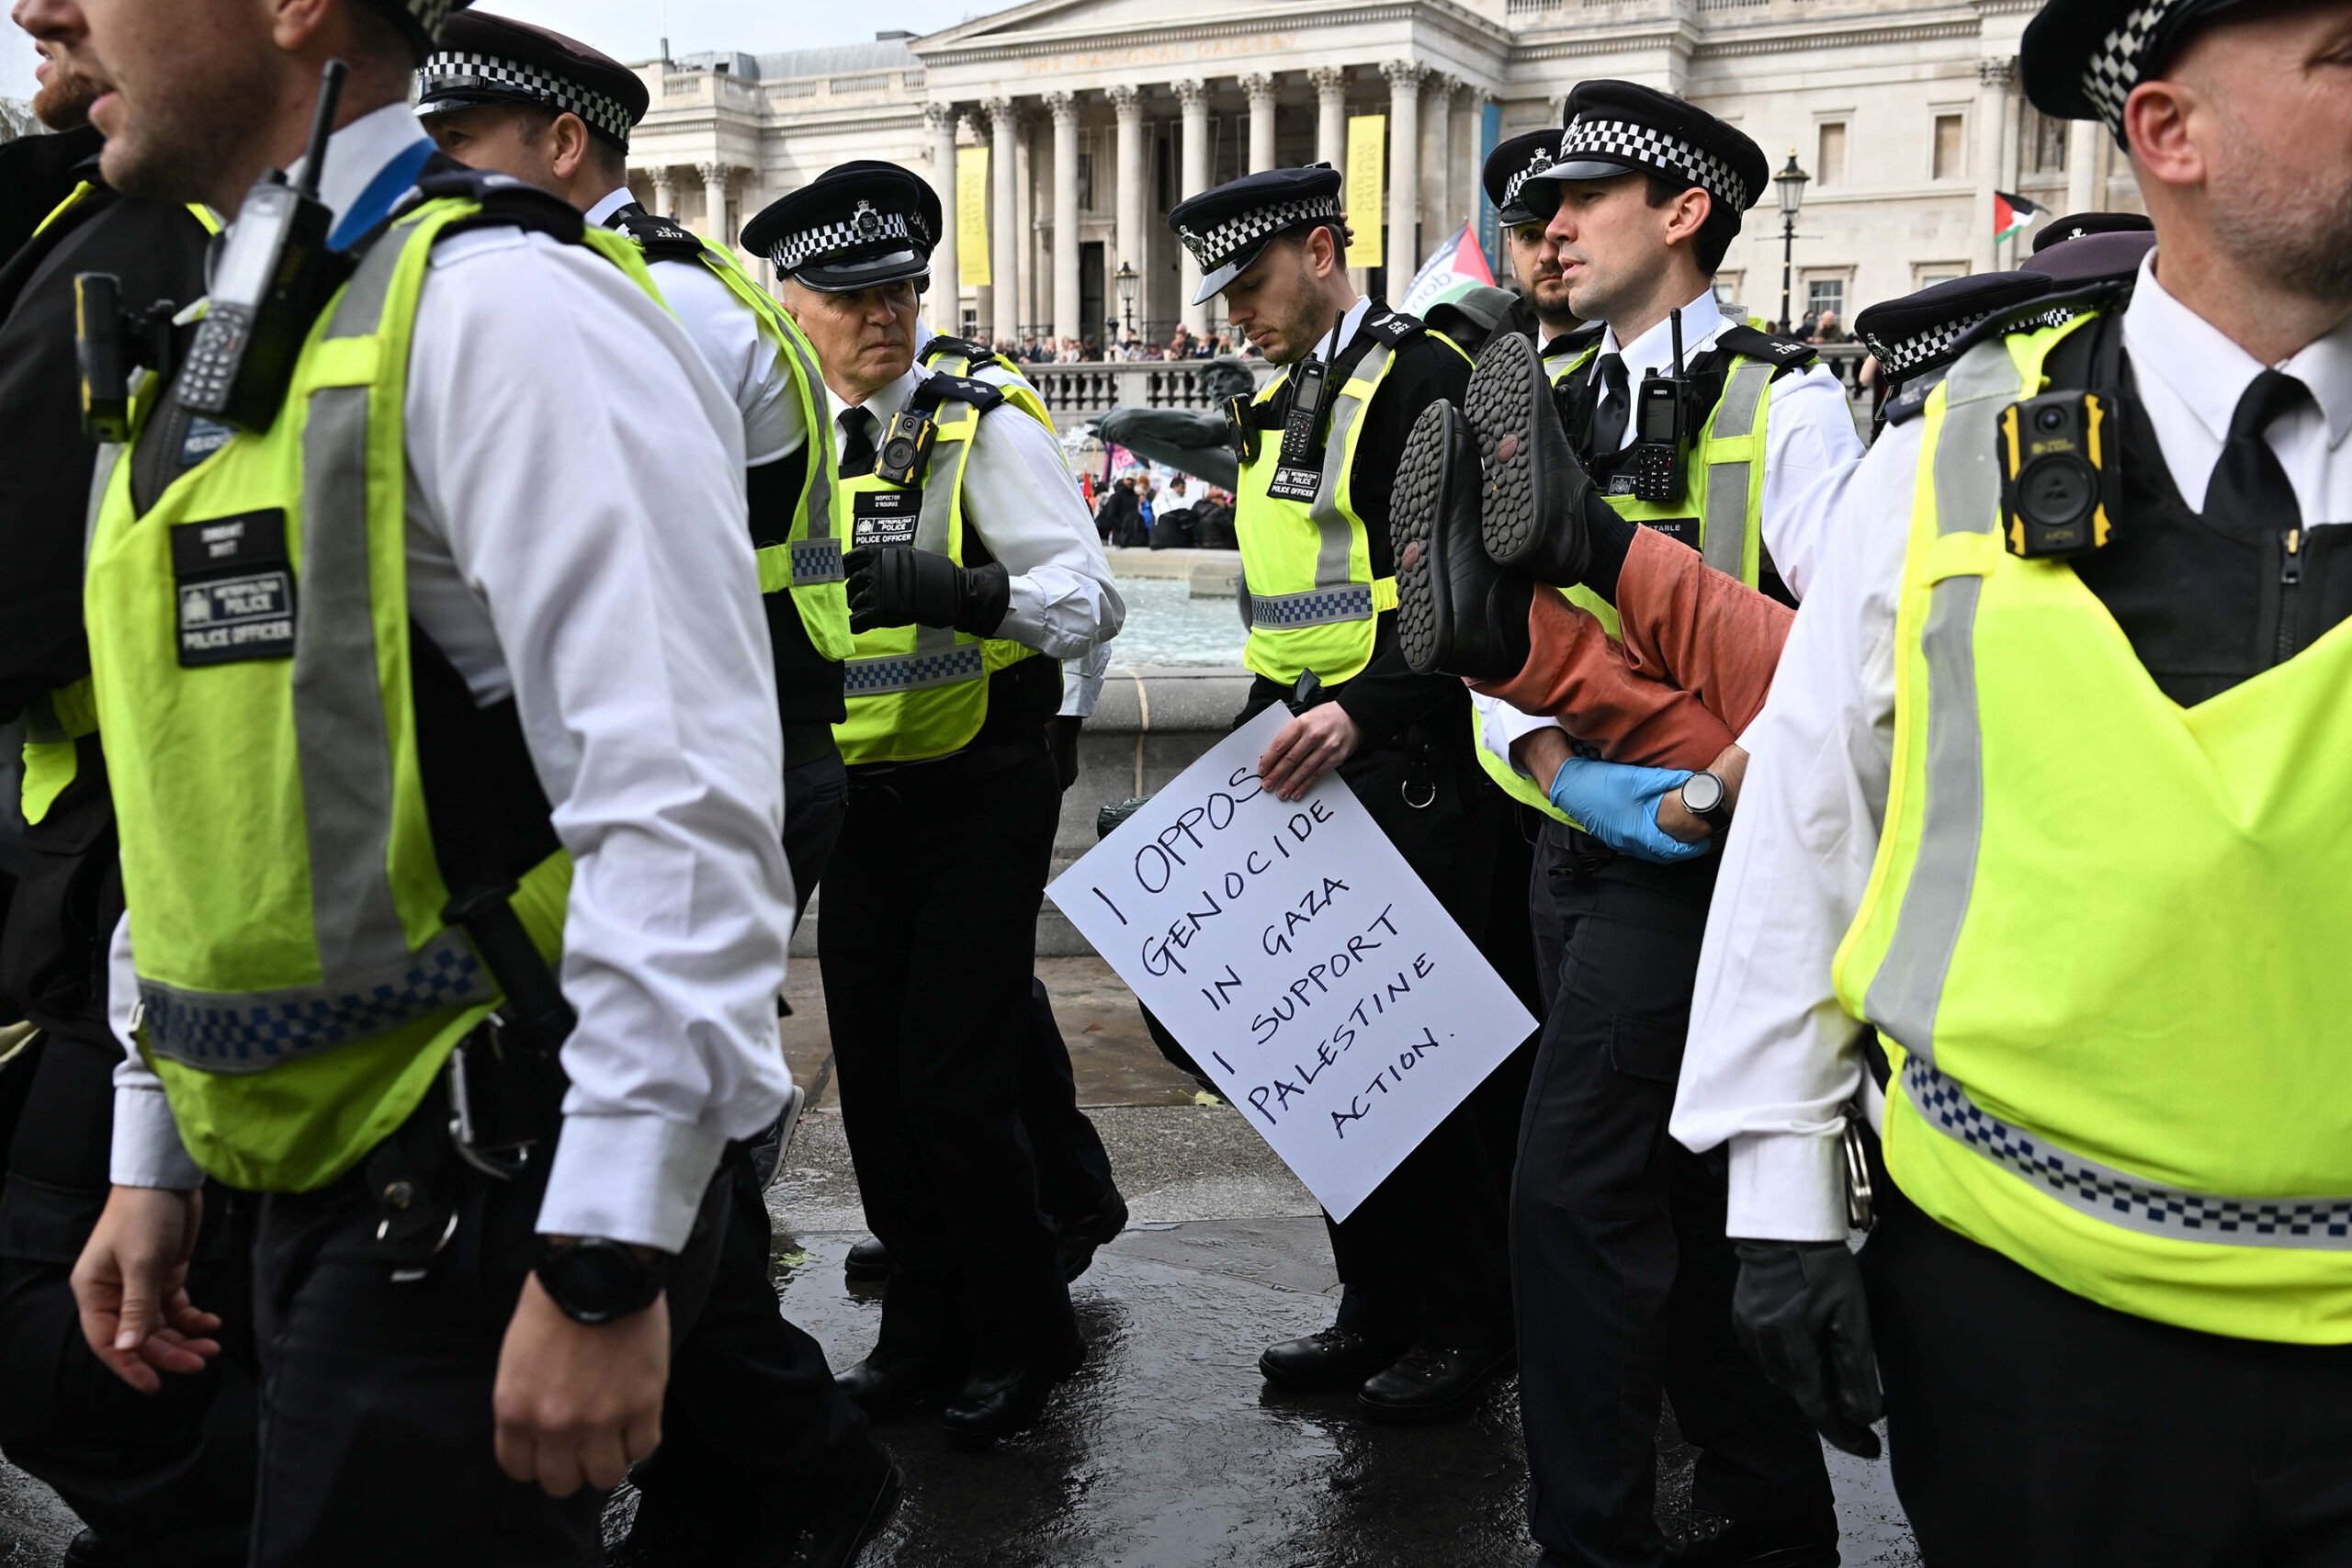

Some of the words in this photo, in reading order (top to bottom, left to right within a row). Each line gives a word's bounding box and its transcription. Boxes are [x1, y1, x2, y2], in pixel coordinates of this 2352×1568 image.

[1022, 56, 1061, 74] THE
[1075, 45, 1183, 68] NATIONAL
[1197, 33, 1297, 58] GALLERY
[1355, 144, 1364, 212] NATIONAL
[1365, 143, 1377, 212] GALLERY
[1271, 485, 1291, 494] POLICE
[1290, 488, 1315, 497] OFFICER
[1292, 477, 1313, 485] POLICE
[855, 536, 880, 544] POLICE
[882, 534, 912, 543] OFFICER
[183, 627, 230, 649] POLICE
[232, 620, 293, 644] OFFICER
[223, 593, 273, 615] POLICE
[1092, 886, 1127, 925] I
[1135, 756, 1265, 894] OPPOS
[1141, 798, 1335, 977] GENOCIDE
[1202, 964, 1242, 1011] IN
[1262, 876, 1351, 956] GAZA
[1212, 1050, 1235, 1075] I
[1250, 903, 1399, 1045] SUPPORT
[1248, 952, 1435, 1125] PALESTINE
[1330, 1026, 1455, 1139] ACTION.
